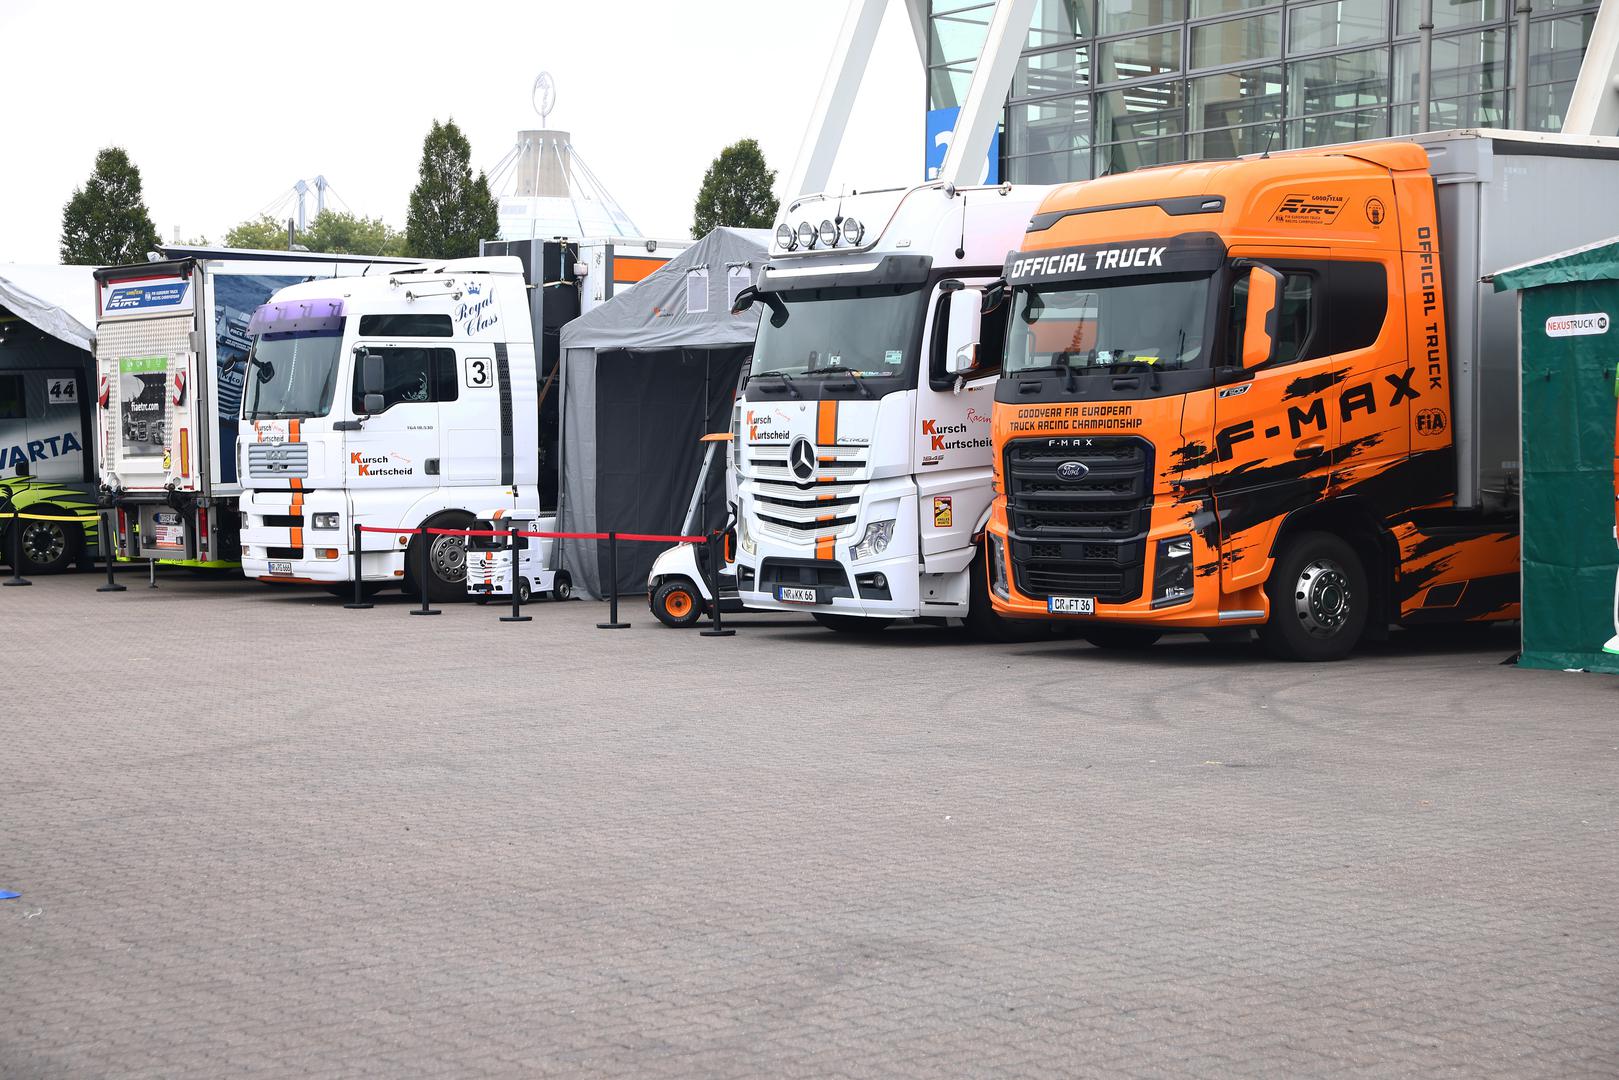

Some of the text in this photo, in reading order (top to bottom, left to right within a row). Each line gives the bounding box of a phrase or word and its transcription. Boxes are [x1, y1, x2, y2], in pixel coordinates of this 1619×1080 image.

[1011, 246, 1167, 279] OFFICIAL TRUCK
[455, 288, 494, 322] Royal
[1418, 226, 1442, 390] OFFICIAL TRUCK
[464, 314, 498, 336] Class
[472, 361, 486, 384] 3
[50, 381, 75, 398] 44
[745, 411, 771, 424] Kursch
[1018, 406, 1132, 418] GOODYEAR FIA EUROPEAN
[1216, 367, 1421, 462] F-MAX
[255, 420, 272, 431] Kursch
[922, 408, 992, 435] Kursch Racin
[1010, 418, 1143, 431] TRUCK RACING CHAMPIONSHIP
[258, 431, 284, 444] Kurtscheid
[750, 426, 790, 440] Kurtscheid
[1048, 439, 1092, 447] F-MAX
[351, 452, 388, 464] Kursch
[358, 464, 413, 476] Kurtscheid
[1062, 464, 1080, 476] Ford
[804, 591, 813, 600] 66
[1055, 599, 1090, 611] CR FT 36
